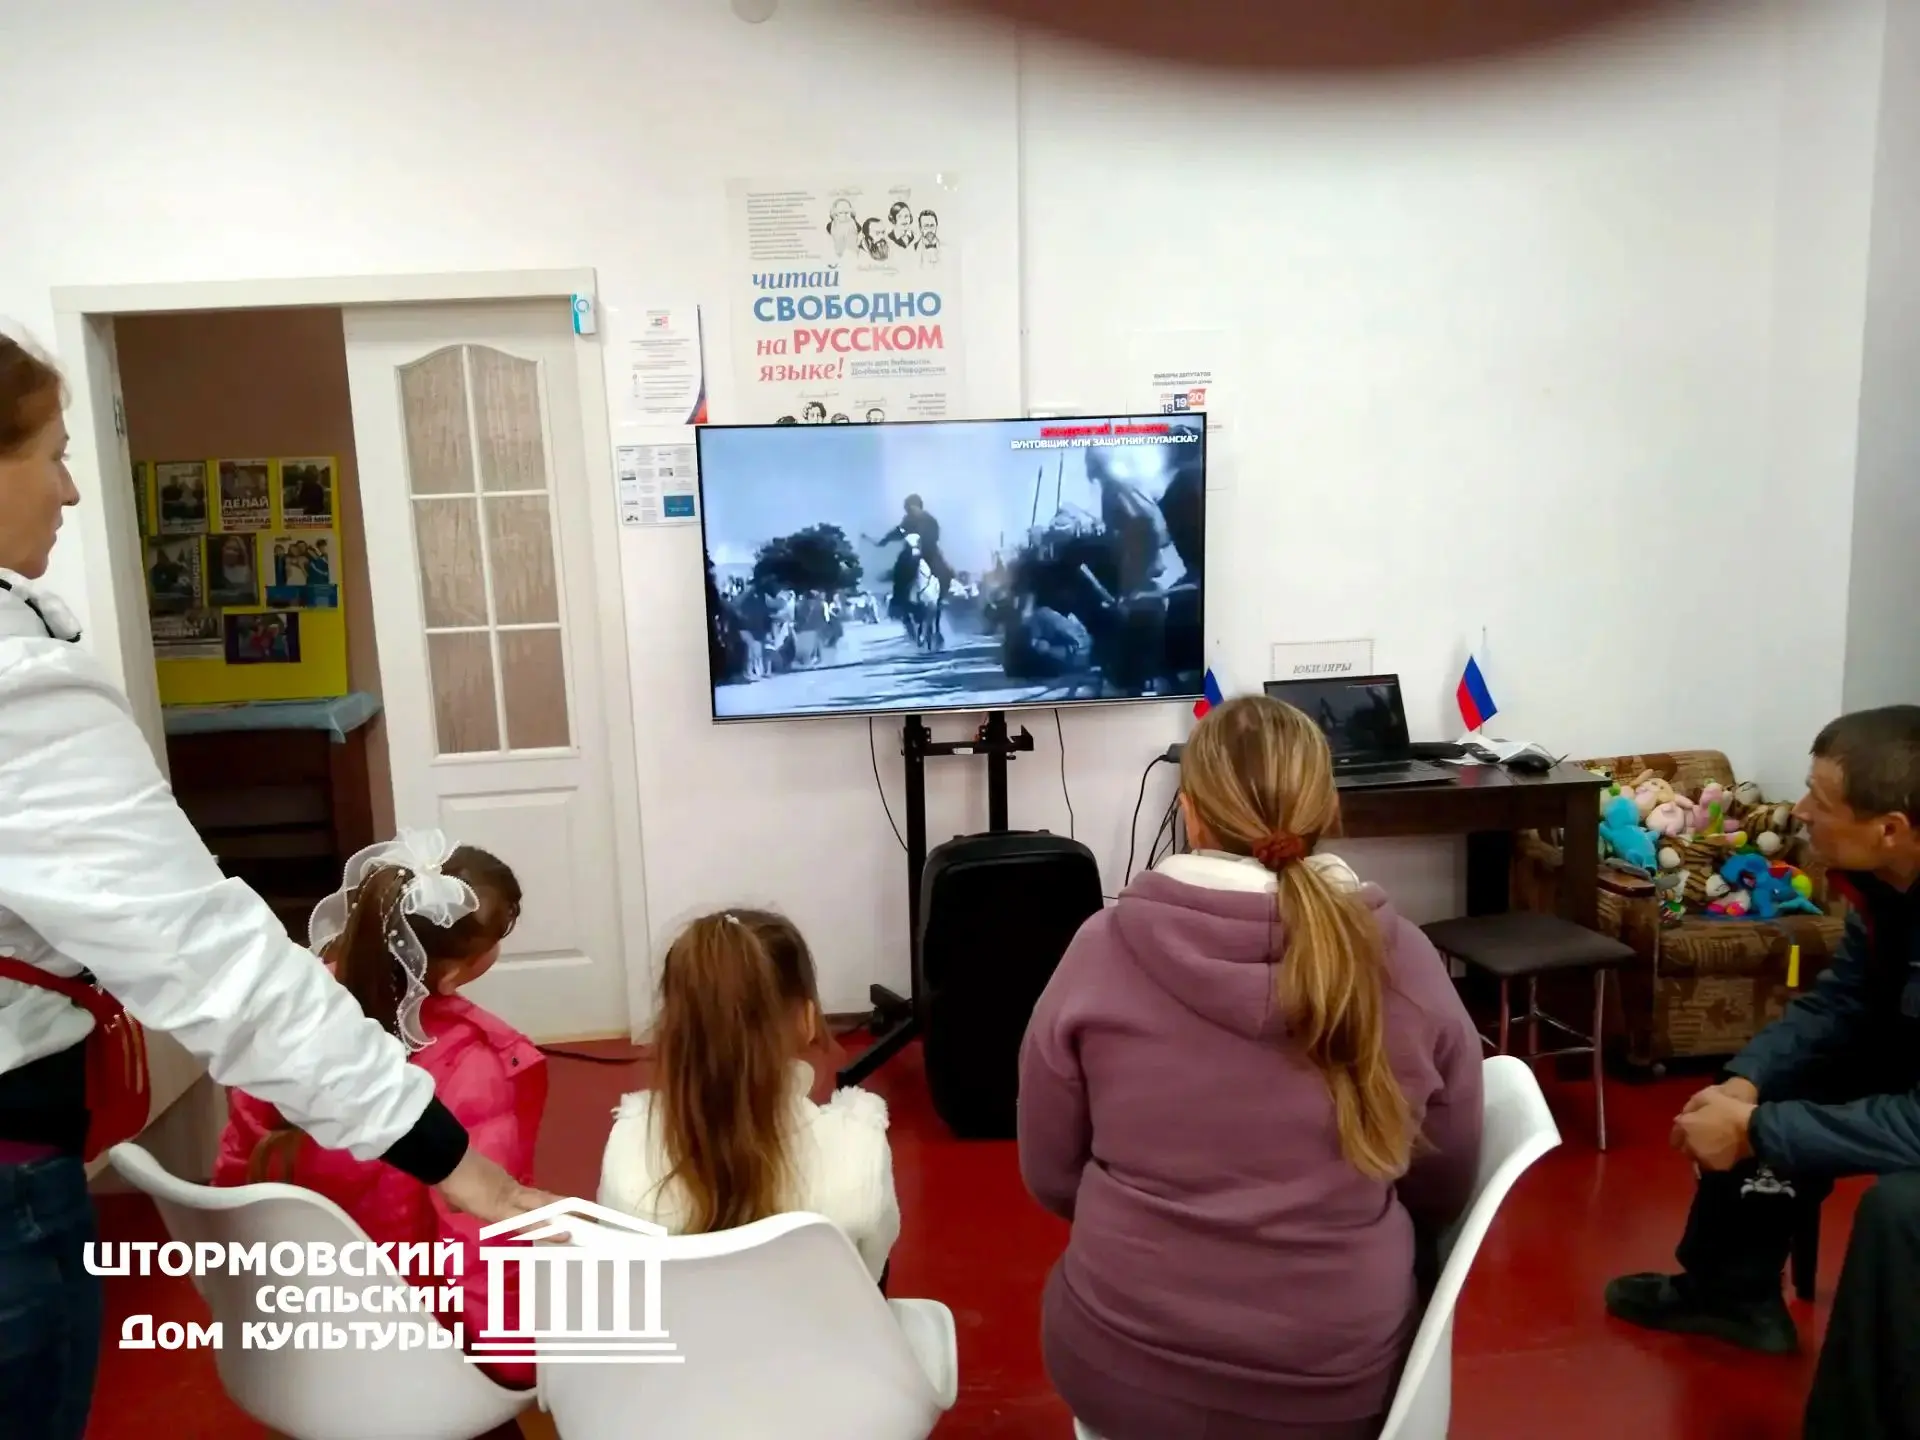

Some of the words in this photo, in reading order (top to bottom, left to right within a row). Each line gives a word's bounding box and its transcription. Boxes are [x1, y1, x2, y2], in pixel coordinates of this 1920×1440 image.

[752, 263, 840, 289] читай
[753, 291, 942, 323] СВОБОДНО
[757, 338, 787, 355] на
[793, 324, 944, 354] РУССКОМ
[759, 357, 844, 382] языке!
[1162, 403, 1174, 413] 18
[1175, 398, 1187, 408] 19
[1189, 392, 1204, 402] 20
[1010, 439, 1069, 450] БУНТОВЩИК
[1071, 438, 1091, 448] ИЛИ
[1092, 436, 1145, 447] ЗАЩИТНИК
[1147, 434, 1199, 445] ЛУГАНСКА?
[223, 496, 269, 508] ДЕЛАЙ
[1293, 662, 1353, 674] ЮБИЛЯРЫ
